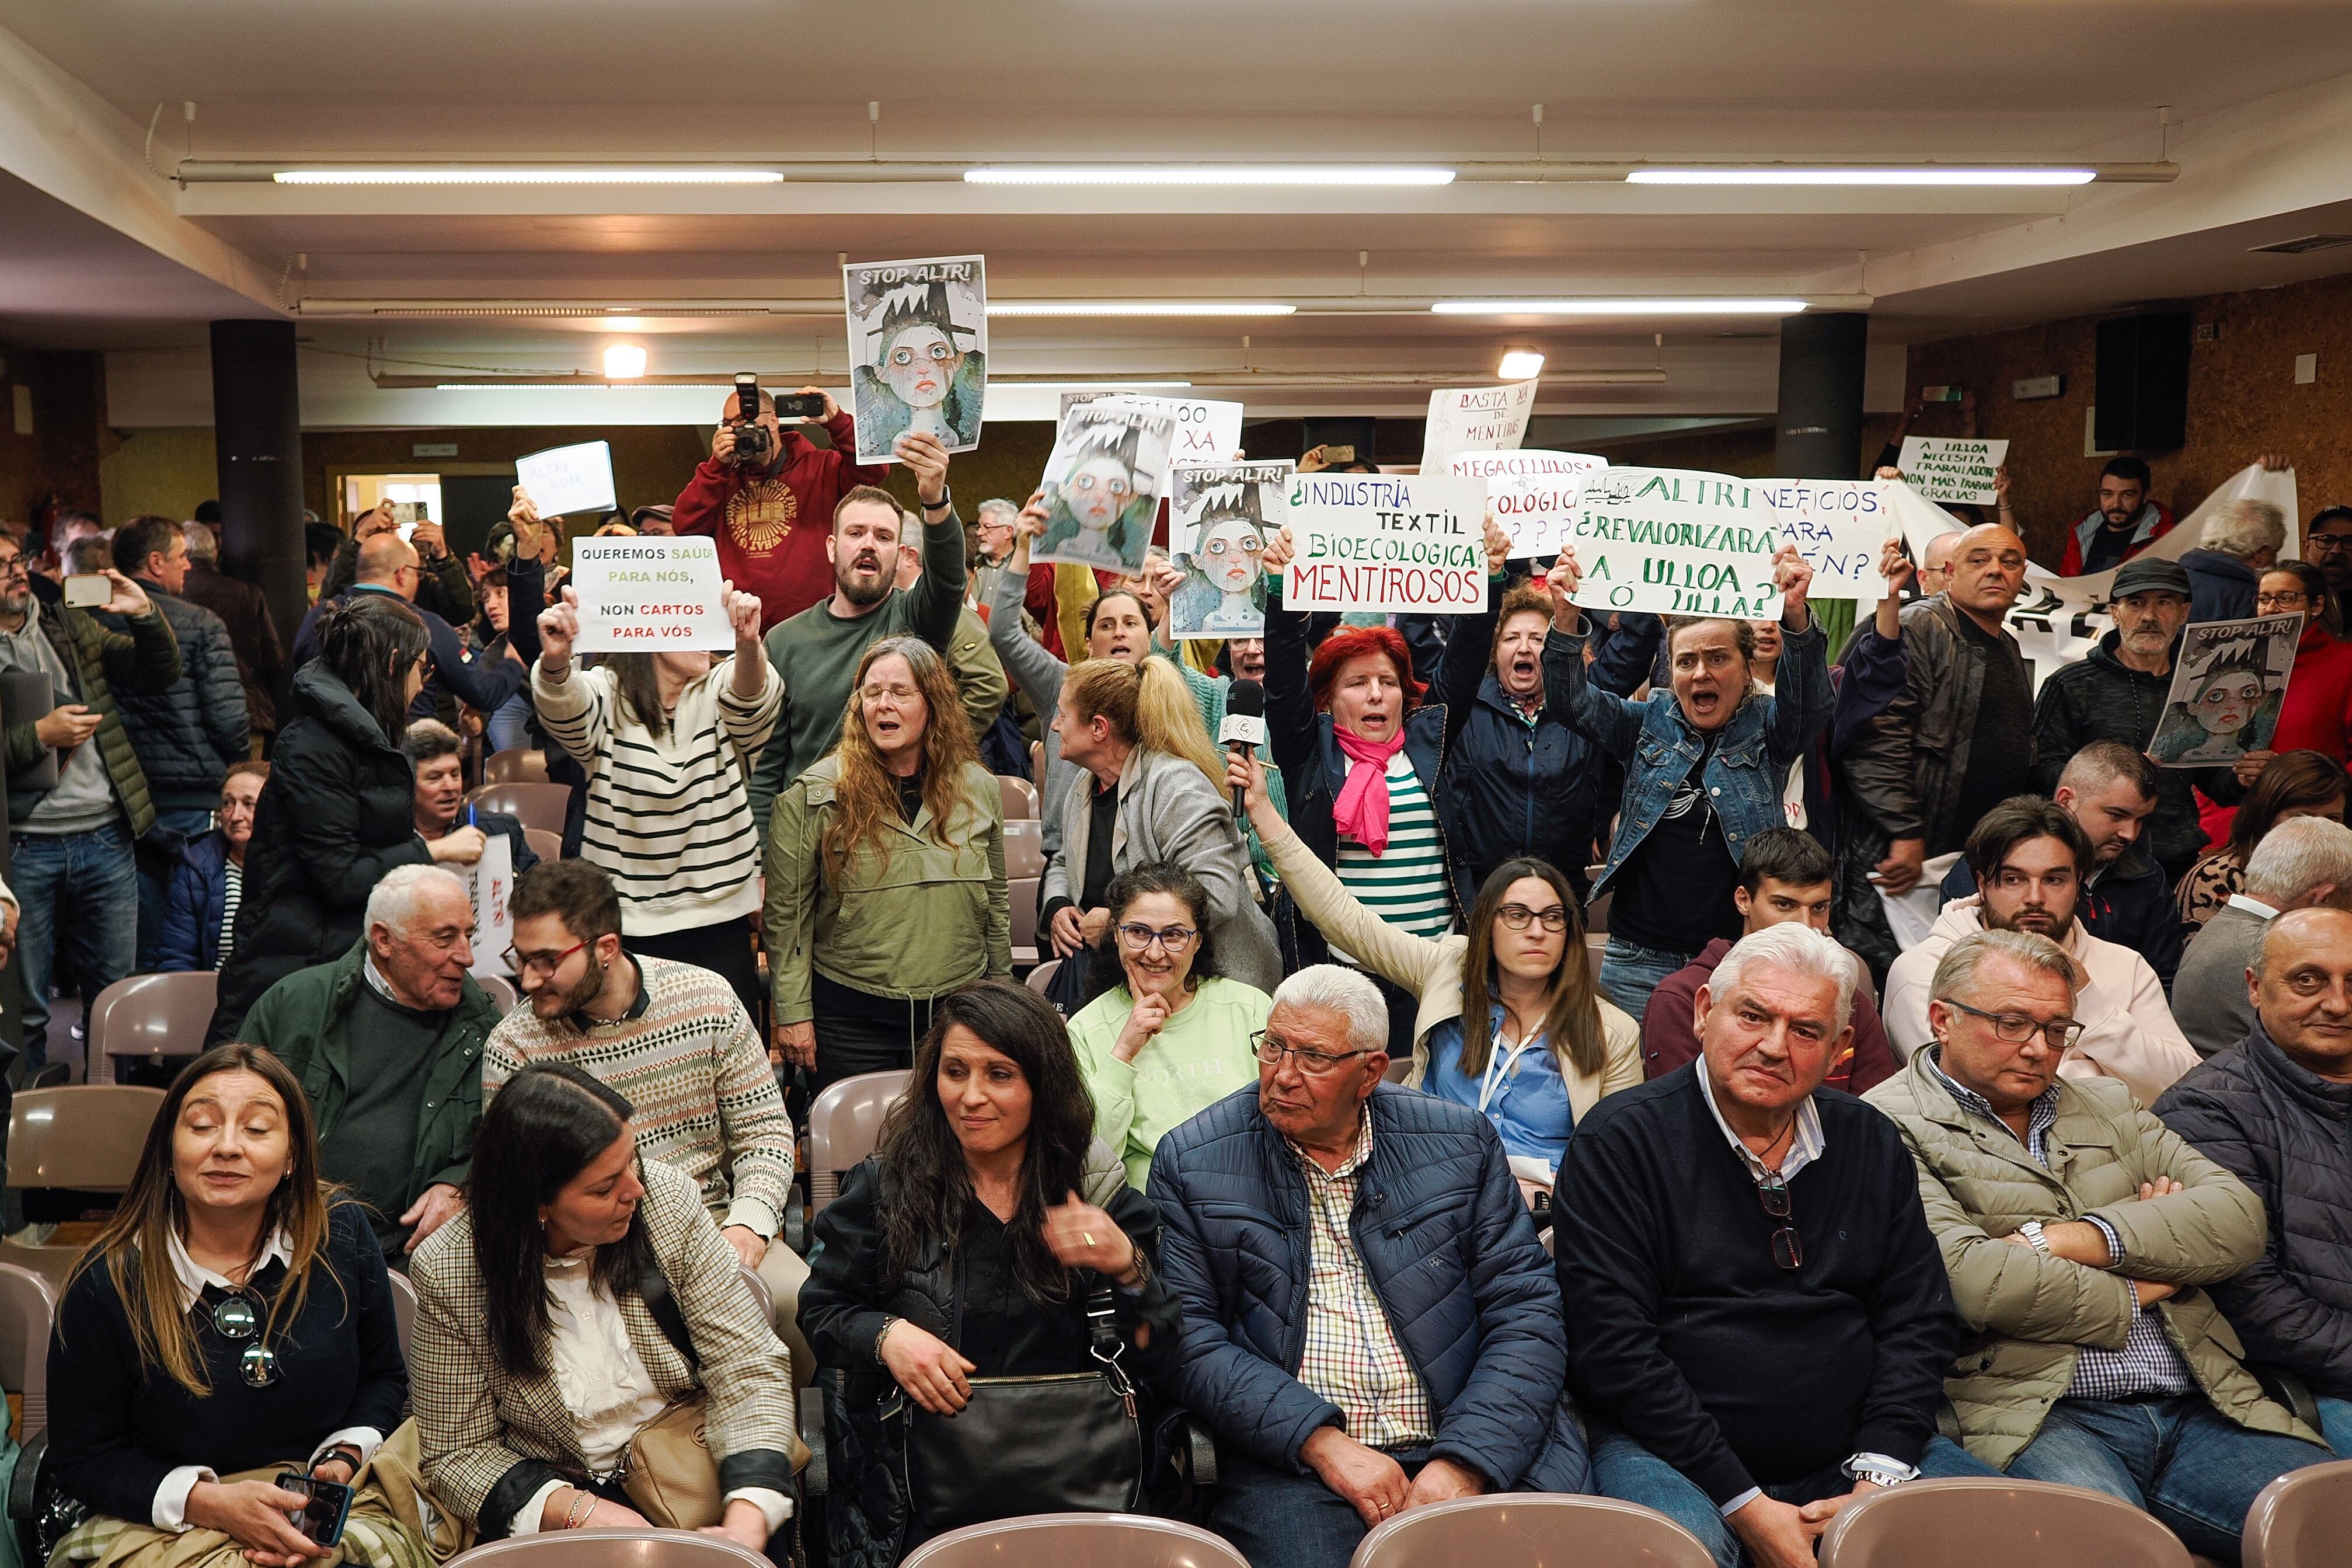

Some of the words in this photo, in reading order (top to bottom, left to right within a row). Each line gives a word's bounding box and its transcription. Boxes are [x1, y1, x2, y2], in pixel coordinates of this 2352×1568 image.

[859, 268, 910, 285] STOP
[914, 263, 972, 281] ALTRI
[1459, 391, 1508, 407] BASTA
[1518, 385, 1528, 402] XA
[1466, 419, 1520, 440] MENTIRAS
[550, 473, 580, 491] NON
[1183, 469, 1228, 483] STOP
[1231, 467, 1283, 483] ALTRI
[1635, 476, 1752, 509] ALTRI
[1921, 487, 1977, 501] GRACIAS
[1376, 509, 1465, 534] TEXTIL
[1779, 521, 1834, 542] ARA
[582, 549, 665, 560] QUEREMOS
[608, 571, 650, 582] PARA
[656, 569, 694, 584] NÓS,
[1292, 563, 1480, 604] MENTIROSOS
[1588, 555, 1611, 580] A
[1643, 557, 1741, 593] ULLOA
[600, 605, 634, 615] NON
[640, 605, 704, 615] CARTOS
[613, 627, 654, 637] PARA
[660, 625, 692, 637] VÓS
[2197, 625, 2243, 640] STOP
[2246, 619, 2293, 637] ALTRI
